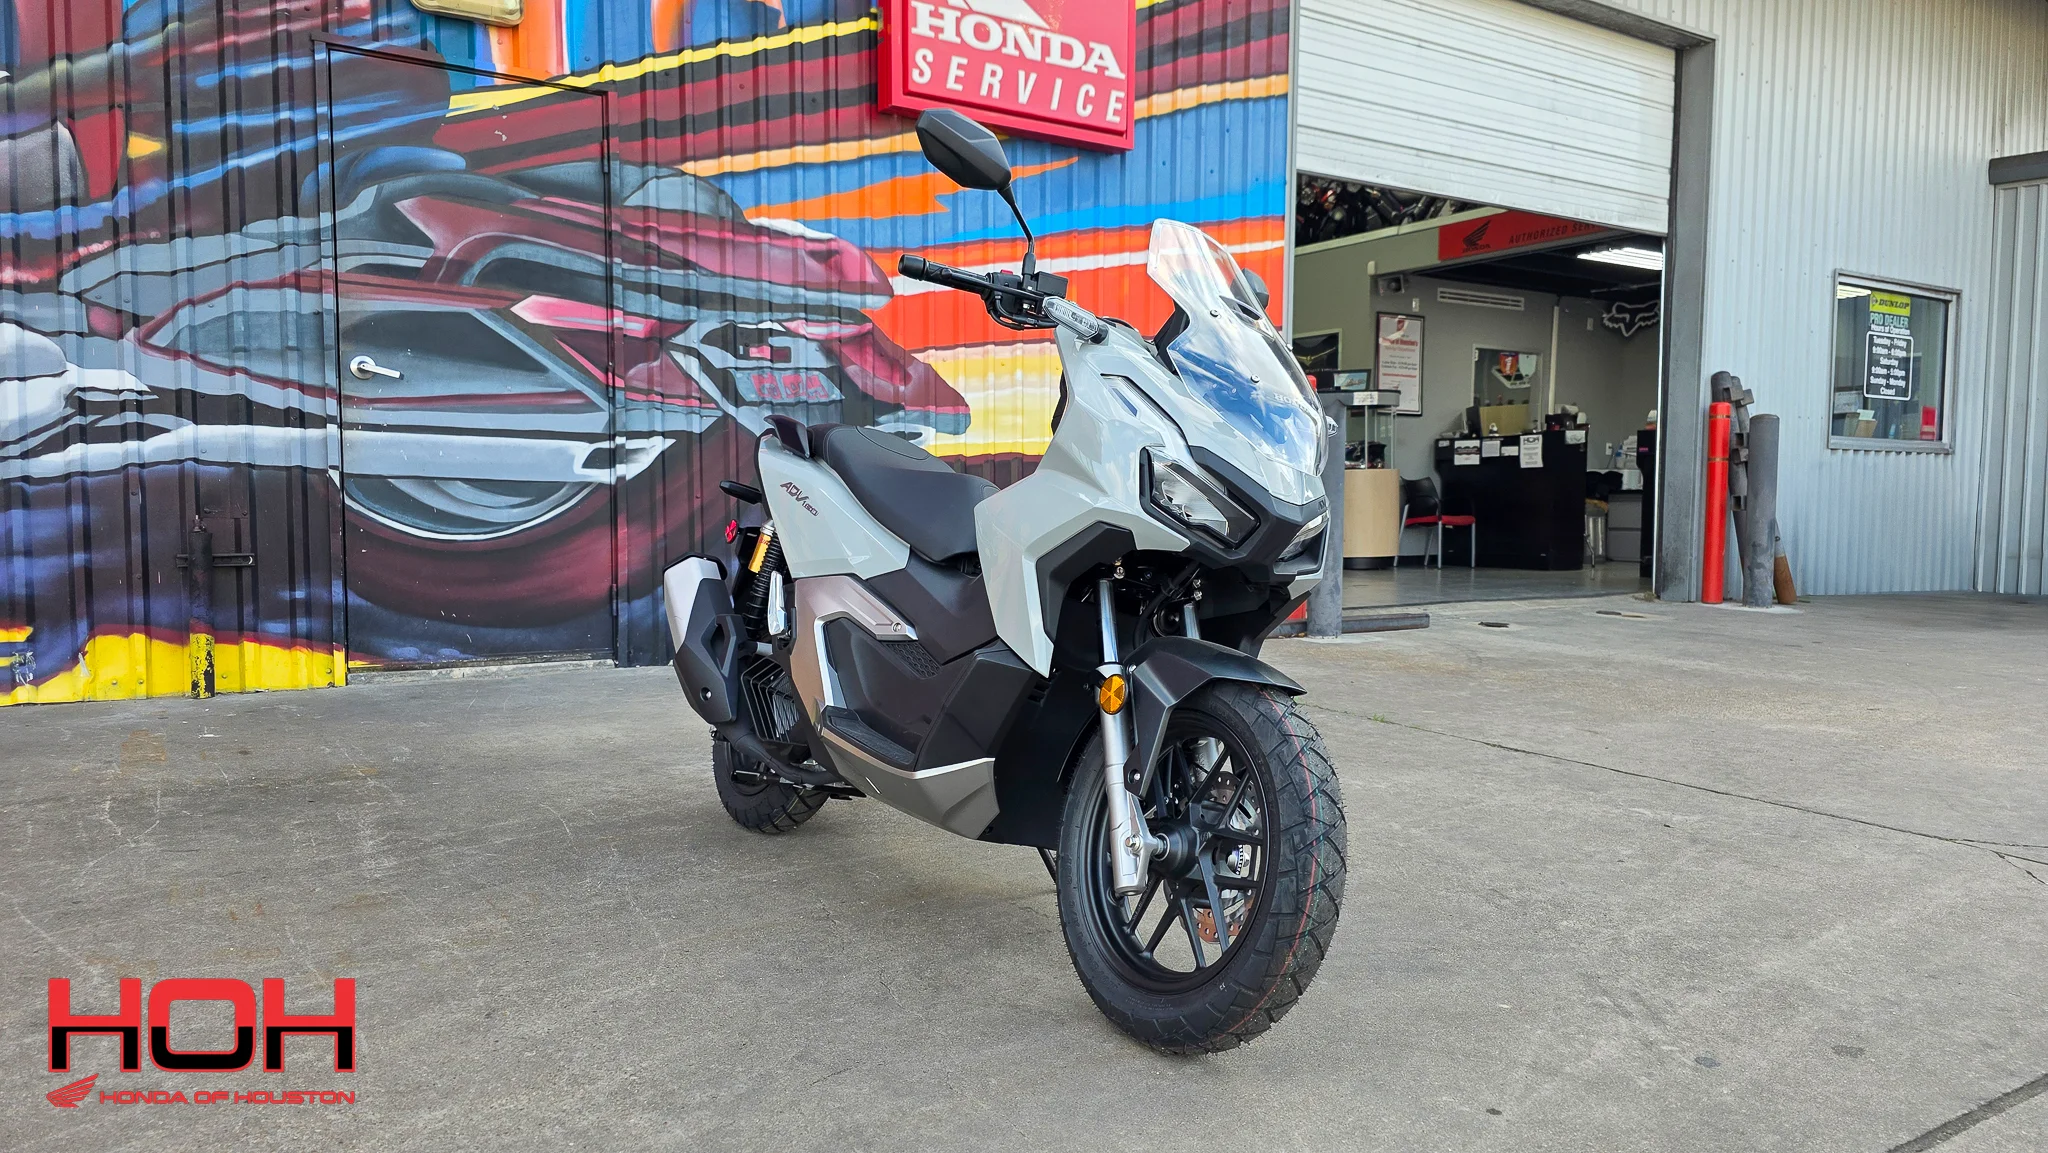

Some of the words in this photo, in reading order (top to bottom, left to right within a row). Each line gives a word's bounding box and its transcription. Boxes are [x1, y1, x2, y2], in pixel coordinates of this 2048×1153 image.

[911, 1, 1126, 80] HONDA
[911, 48, 1126, 124] SERVICE
[1508, 224, 1568, 244] AUTHORIZED
[1880, 300, 1910, 308] DUNLOP
[1870, 312, 1884, 324] PRO
[1884, 314, 1908, 328] DEALER
[1874, 336, 1890, 346] Tuesday
[1894, 338, 1906, 348] Friday
[1880, 356, 1898, 368] Saturday
[1870, 376, 1886, 386] Sunday
[1890, 378, 1906, 388] Monday
[1880, 386, 1896, 396] Closed
[780, 481, 809, 502] ADV
